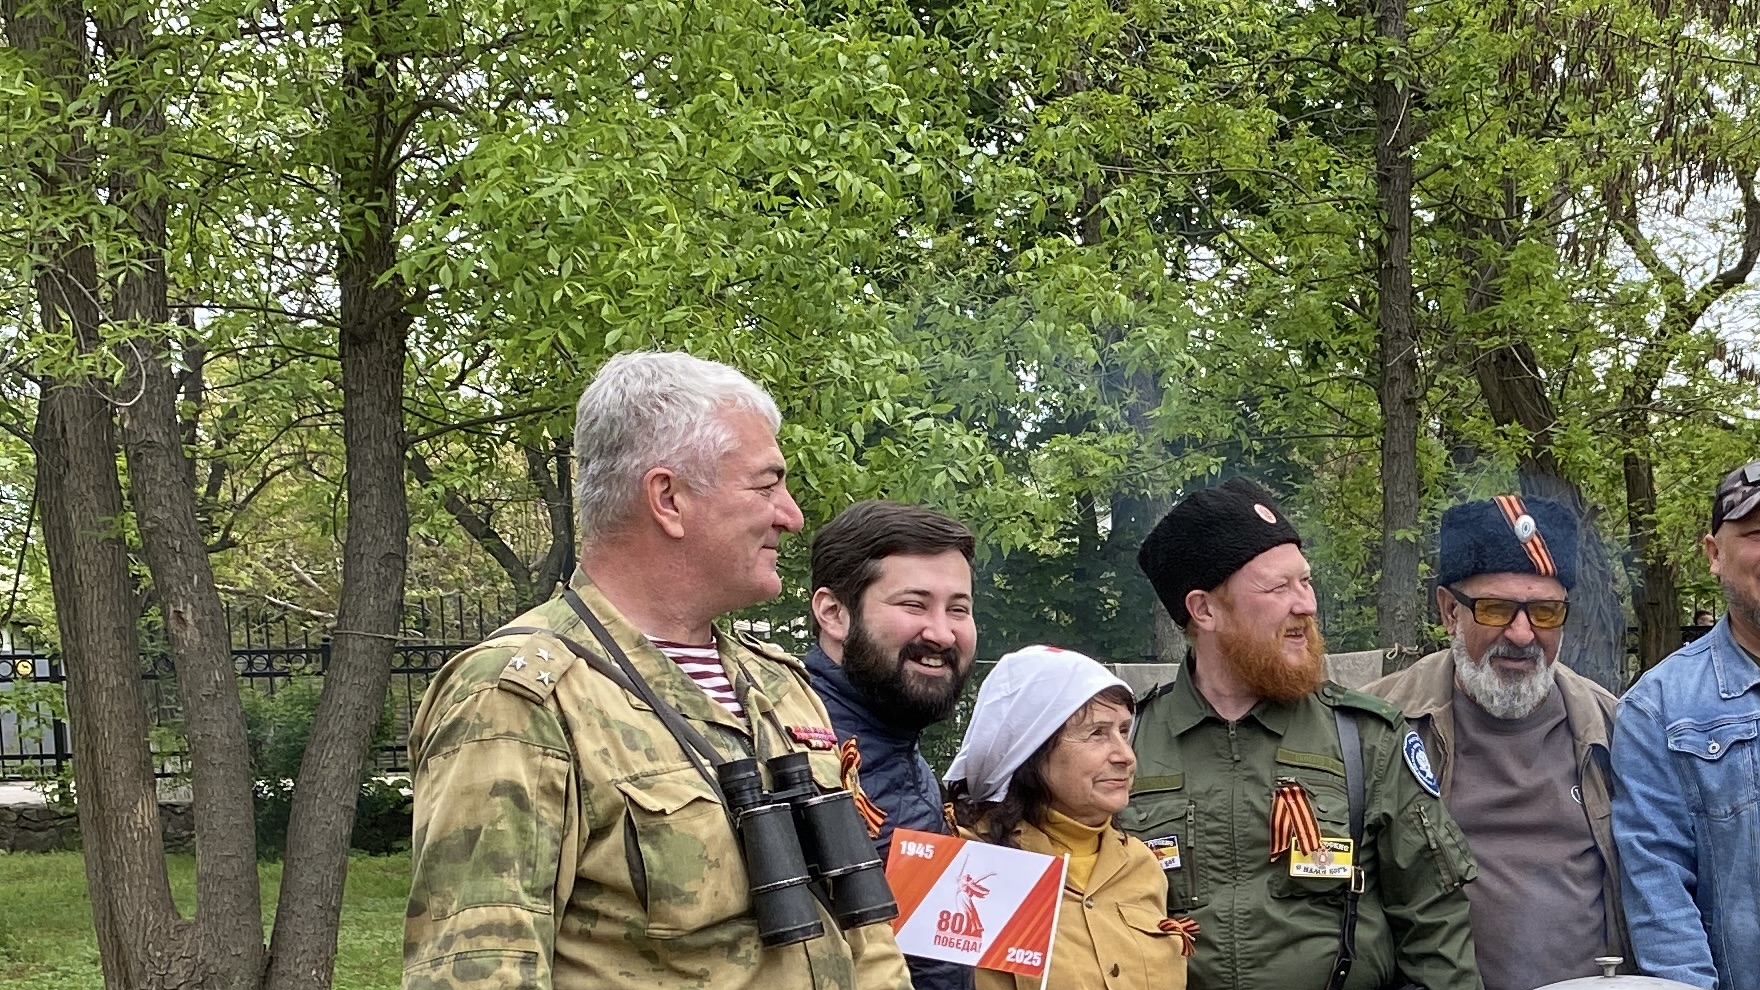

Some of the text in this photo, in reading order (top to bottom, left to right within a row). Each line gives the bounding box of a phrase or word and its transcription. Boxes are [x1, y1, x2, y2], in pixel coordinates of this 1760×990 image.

[900, 840, 935, 860] 1945
[937, 910, 965, 935] 80
[933, 934, 983, 954] ПОБЕДА!
[1005, 947, 1043, 967] 2025
